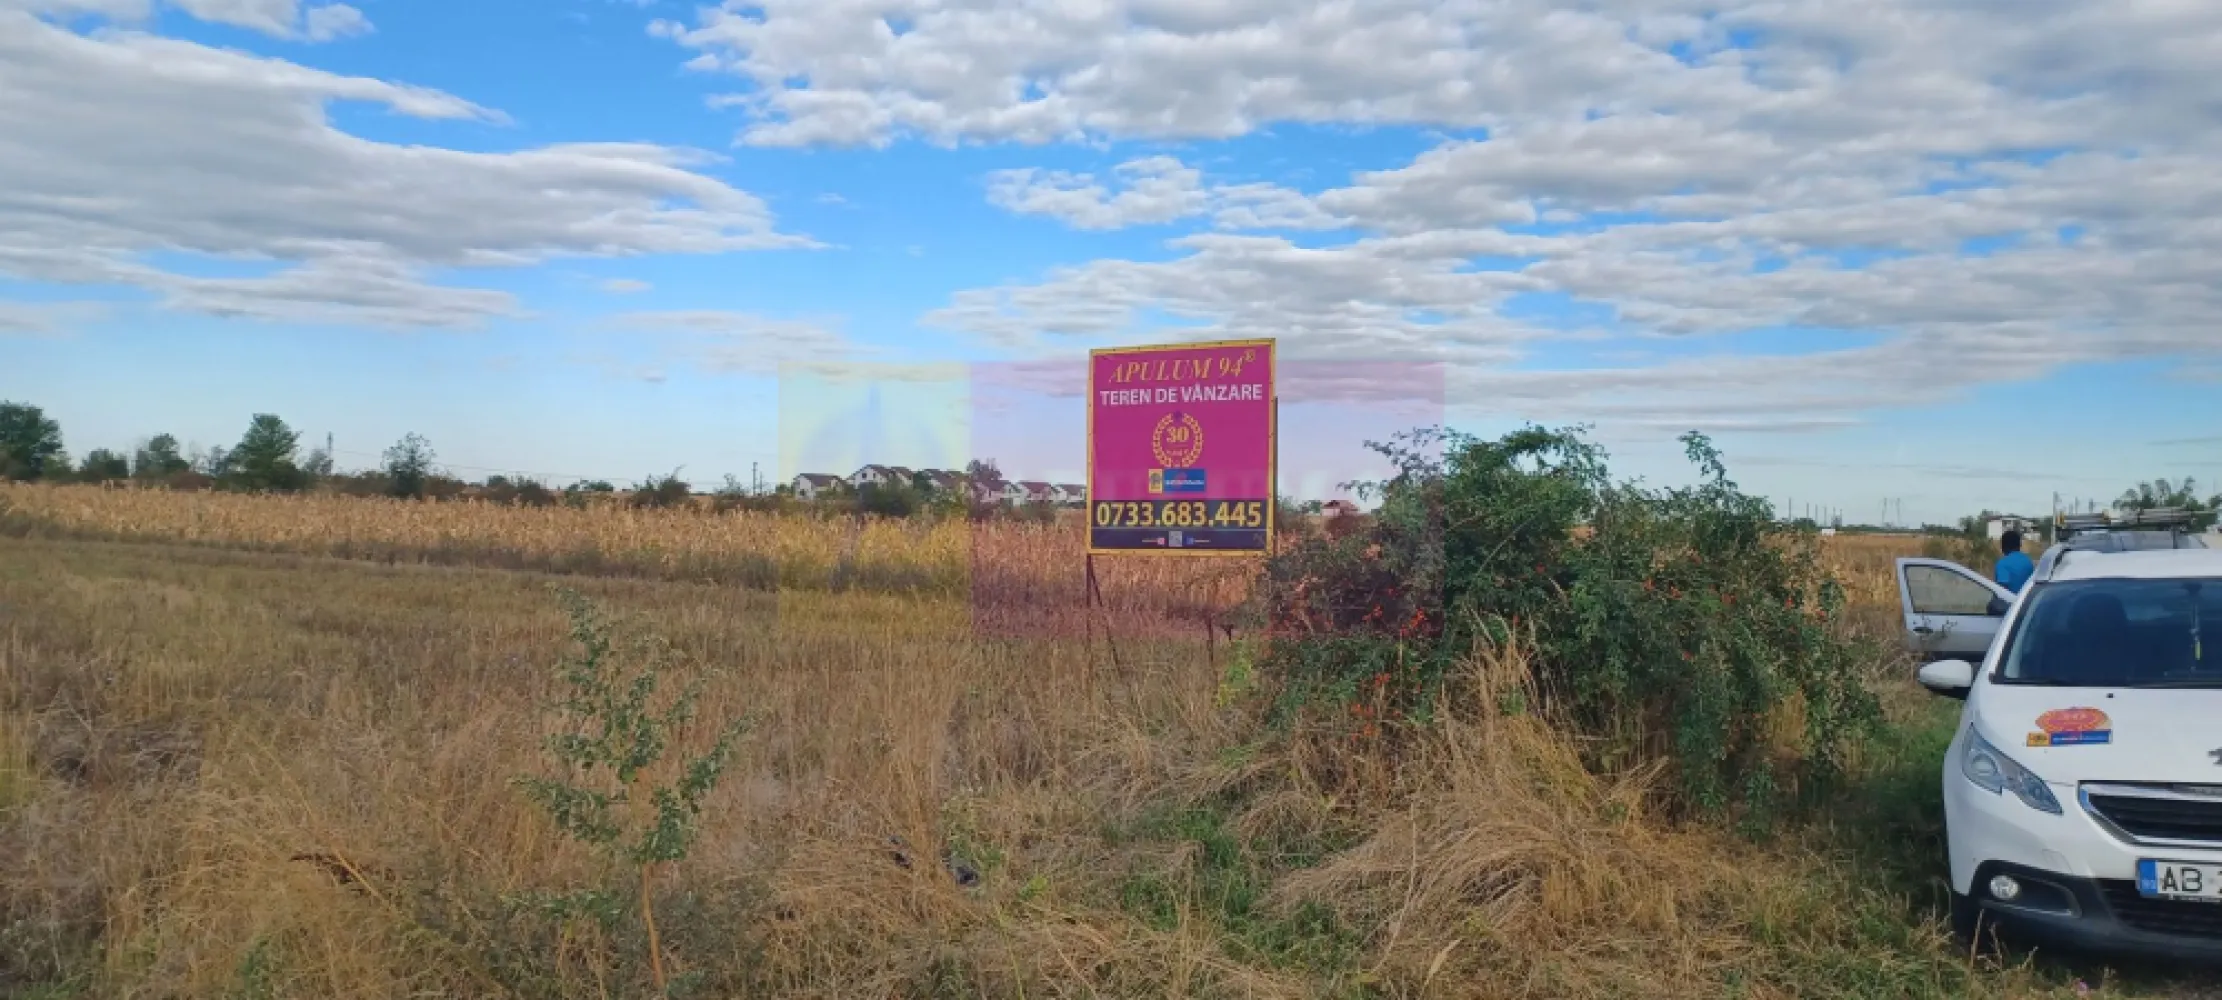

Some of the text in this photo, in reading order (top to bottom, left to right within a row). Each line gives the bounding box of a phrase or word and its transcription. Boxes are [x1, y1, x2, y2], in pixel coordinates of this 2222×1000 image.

[1109, 357, 1212, 384] APULUM
[1099, 382, 1263, 406] TEREN DE VÂNZARE
[1166, 425, 1189, 444] 30
[1096, 501, 1262, 528] 0733.683.445
[2161, 866, 2202, 891] AB
